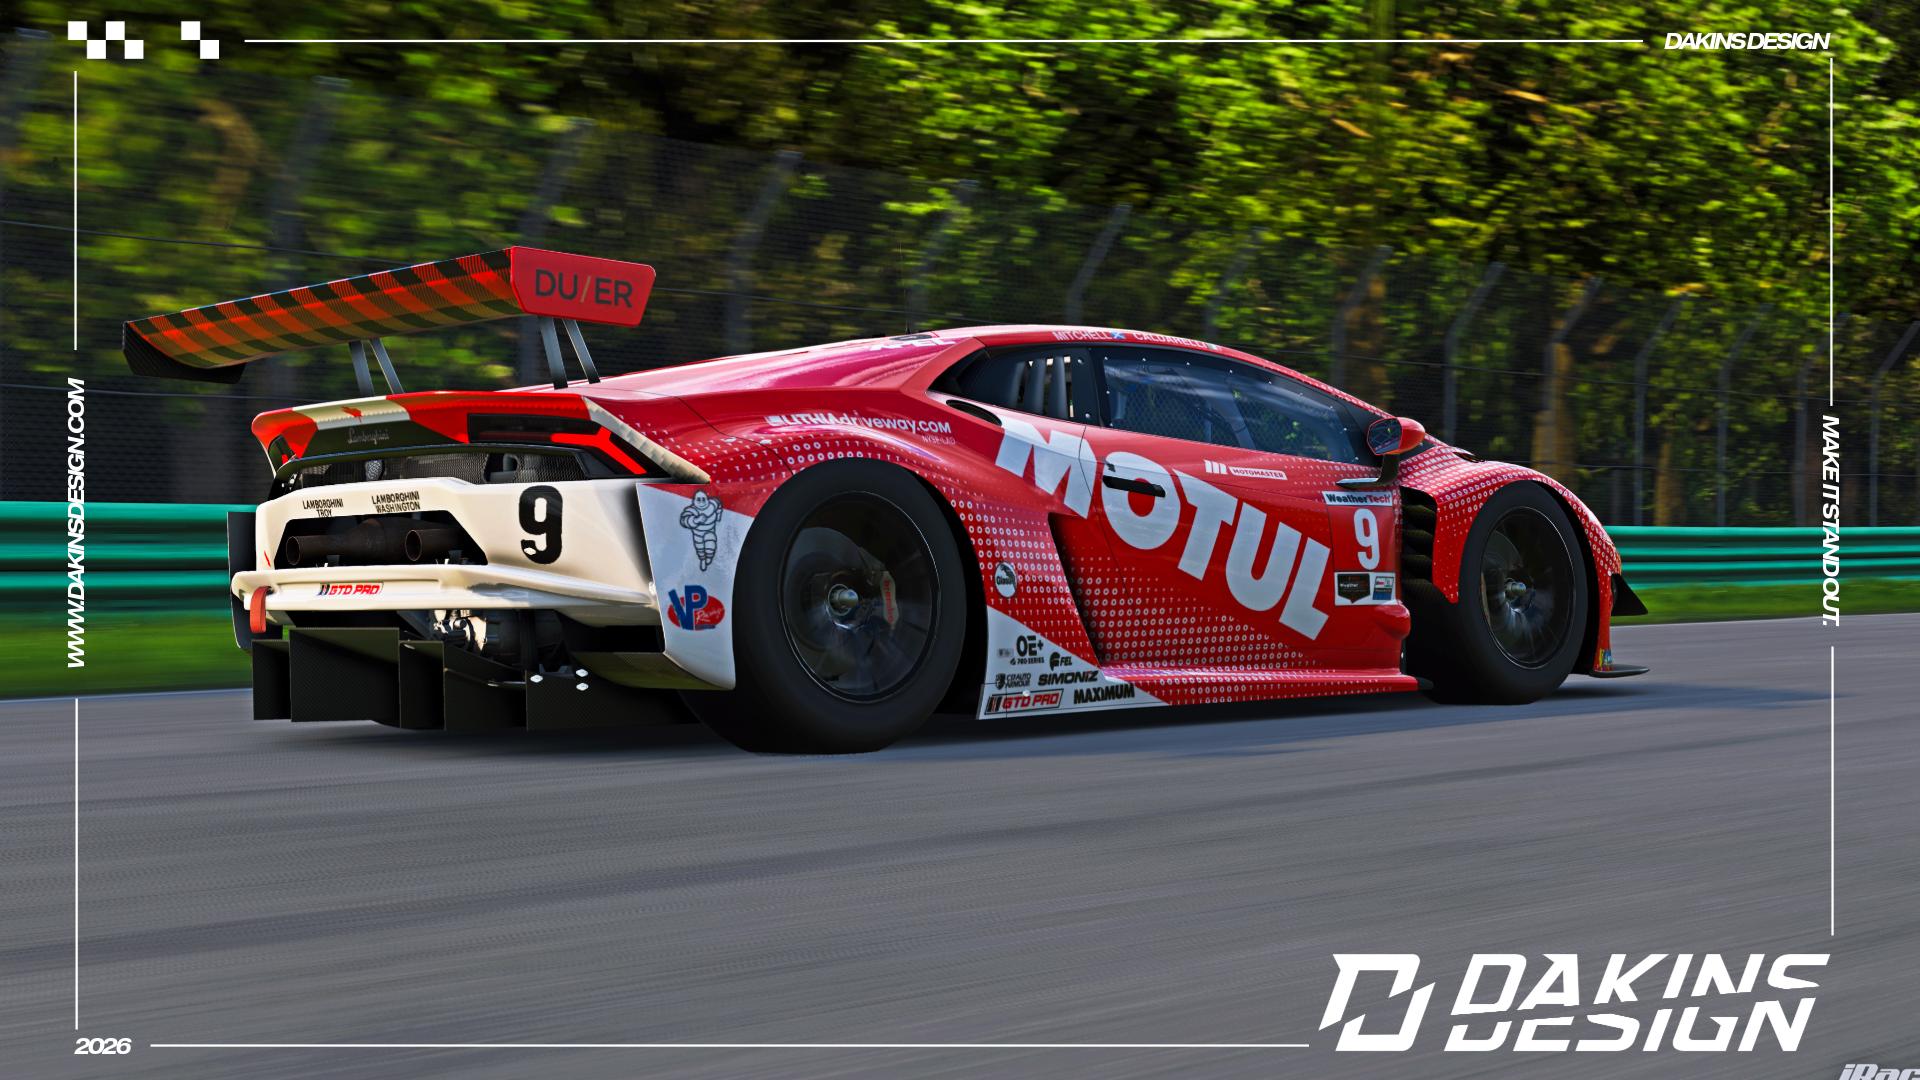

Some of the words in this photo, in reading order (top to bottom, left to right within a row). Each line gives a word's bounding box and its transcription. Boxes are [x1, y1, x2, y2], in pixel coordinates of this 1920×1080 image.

[535, 269, 633, 308] DU/ER
[1052, 330, 1113, 341] MITCHELL
[1233, 468, 1284, 478] MOTOMASTER
[303, 498, 344, 509] LAMBORGHINI
[371, 491, 420, 504] LAMBORGHINI
[1326, 493, 1390, 504] WeatherTech
[375, 502, 420, 514] WASHINGTON
[519, 485, 563, 564] 9
[995, 415, 1331, 641] MOTUL
[1354, 508, 1380, 570] 9
[328, 584, 353, 596] GTD
[353, 584, 380, 595] PRO
[668, 585, 708, 631] VP
[1060, 656, 1072, 666] FEL
[1038, 670, 1099, 686] SIMONIZ
[1002, 695, 1031, 709] GTD
[1033, 692, 1059, 706] PRO
[1074, 683, 1135, 705] MAXIMUM
